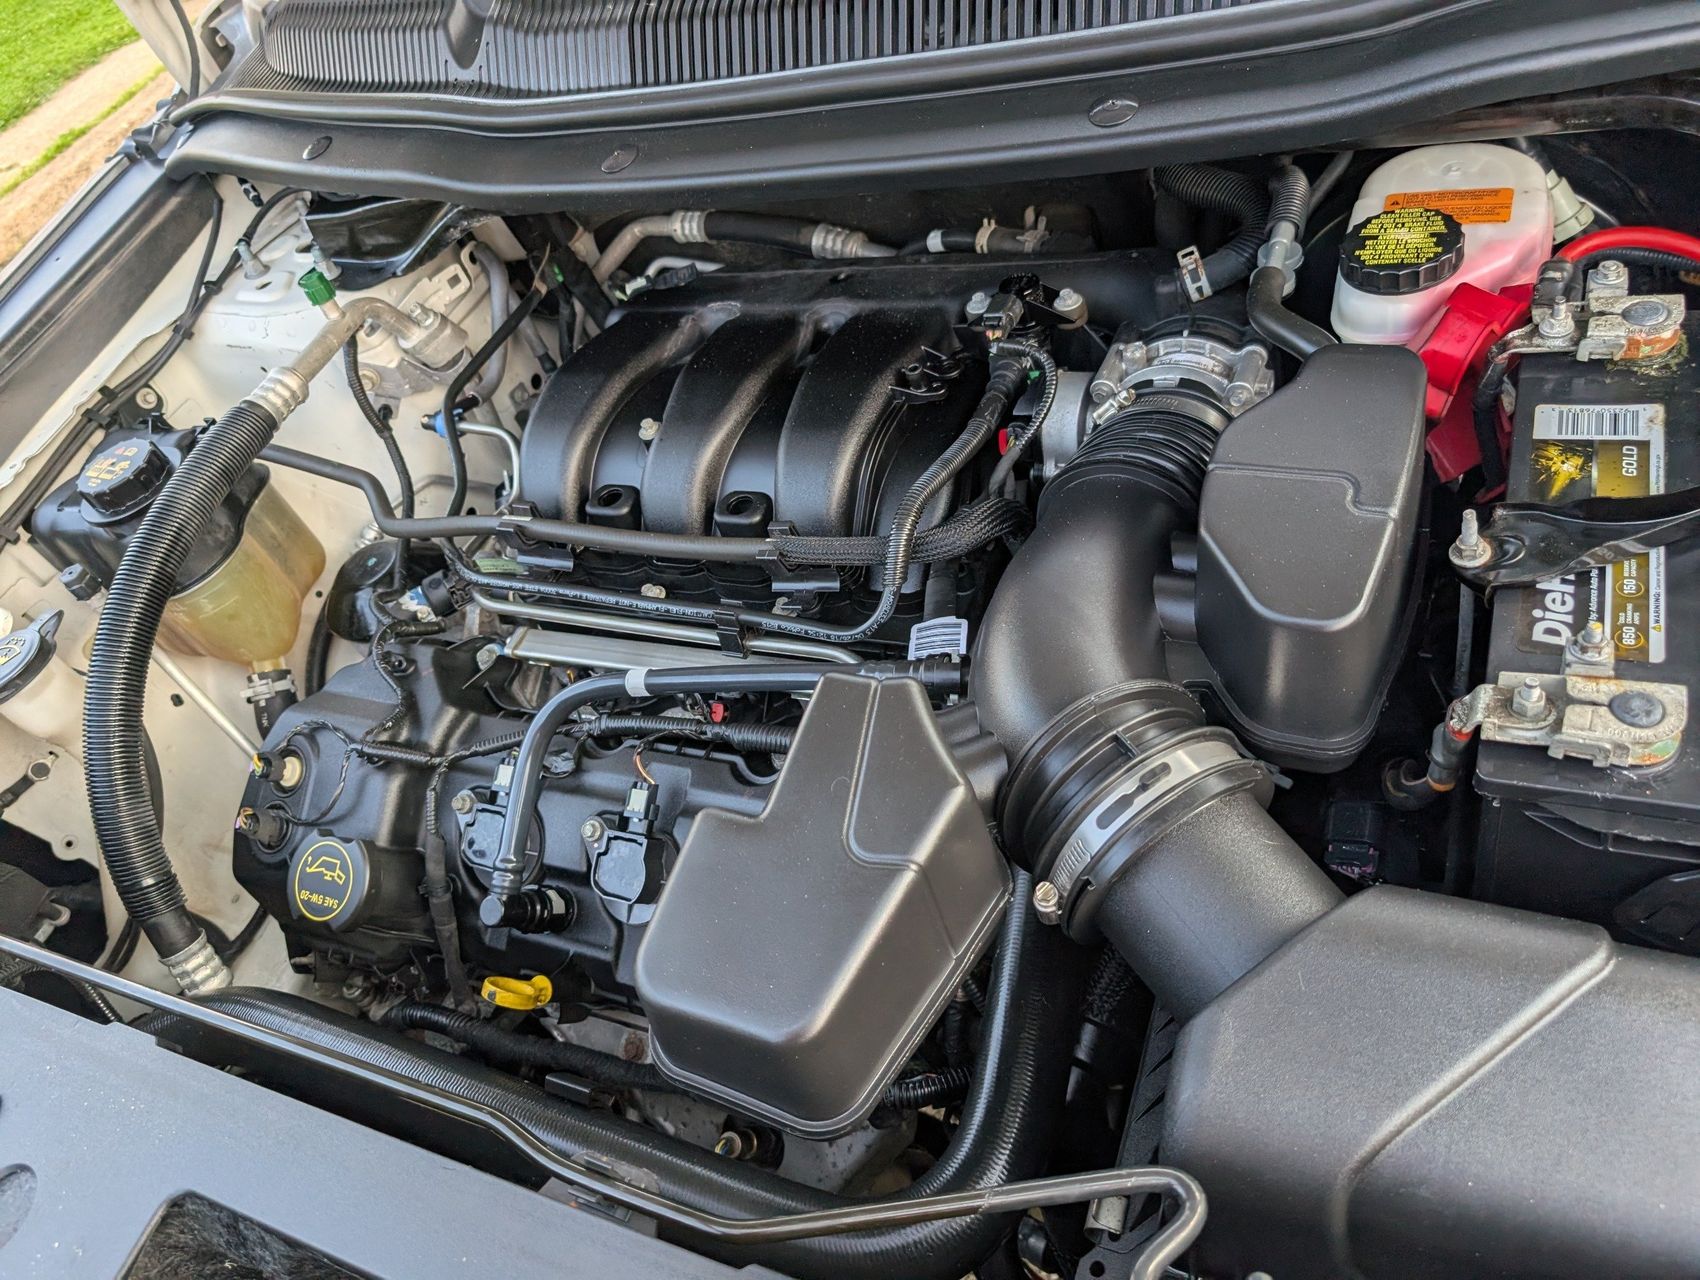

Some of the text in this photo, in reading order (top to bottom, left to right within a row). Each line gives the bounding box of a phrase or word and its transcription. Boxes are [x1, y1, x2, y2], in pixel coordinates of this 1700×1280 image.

[1622, 445, 1638, 476] GOLD
[1590, 577, 1598, 590] Auto
[1624, 578, 1636, 594] 150
[1588, 590, 1598, 611] Advance
[1622, 626, 1636, 645] 850
[300, 890, 338, 909] SAE 5W-20
